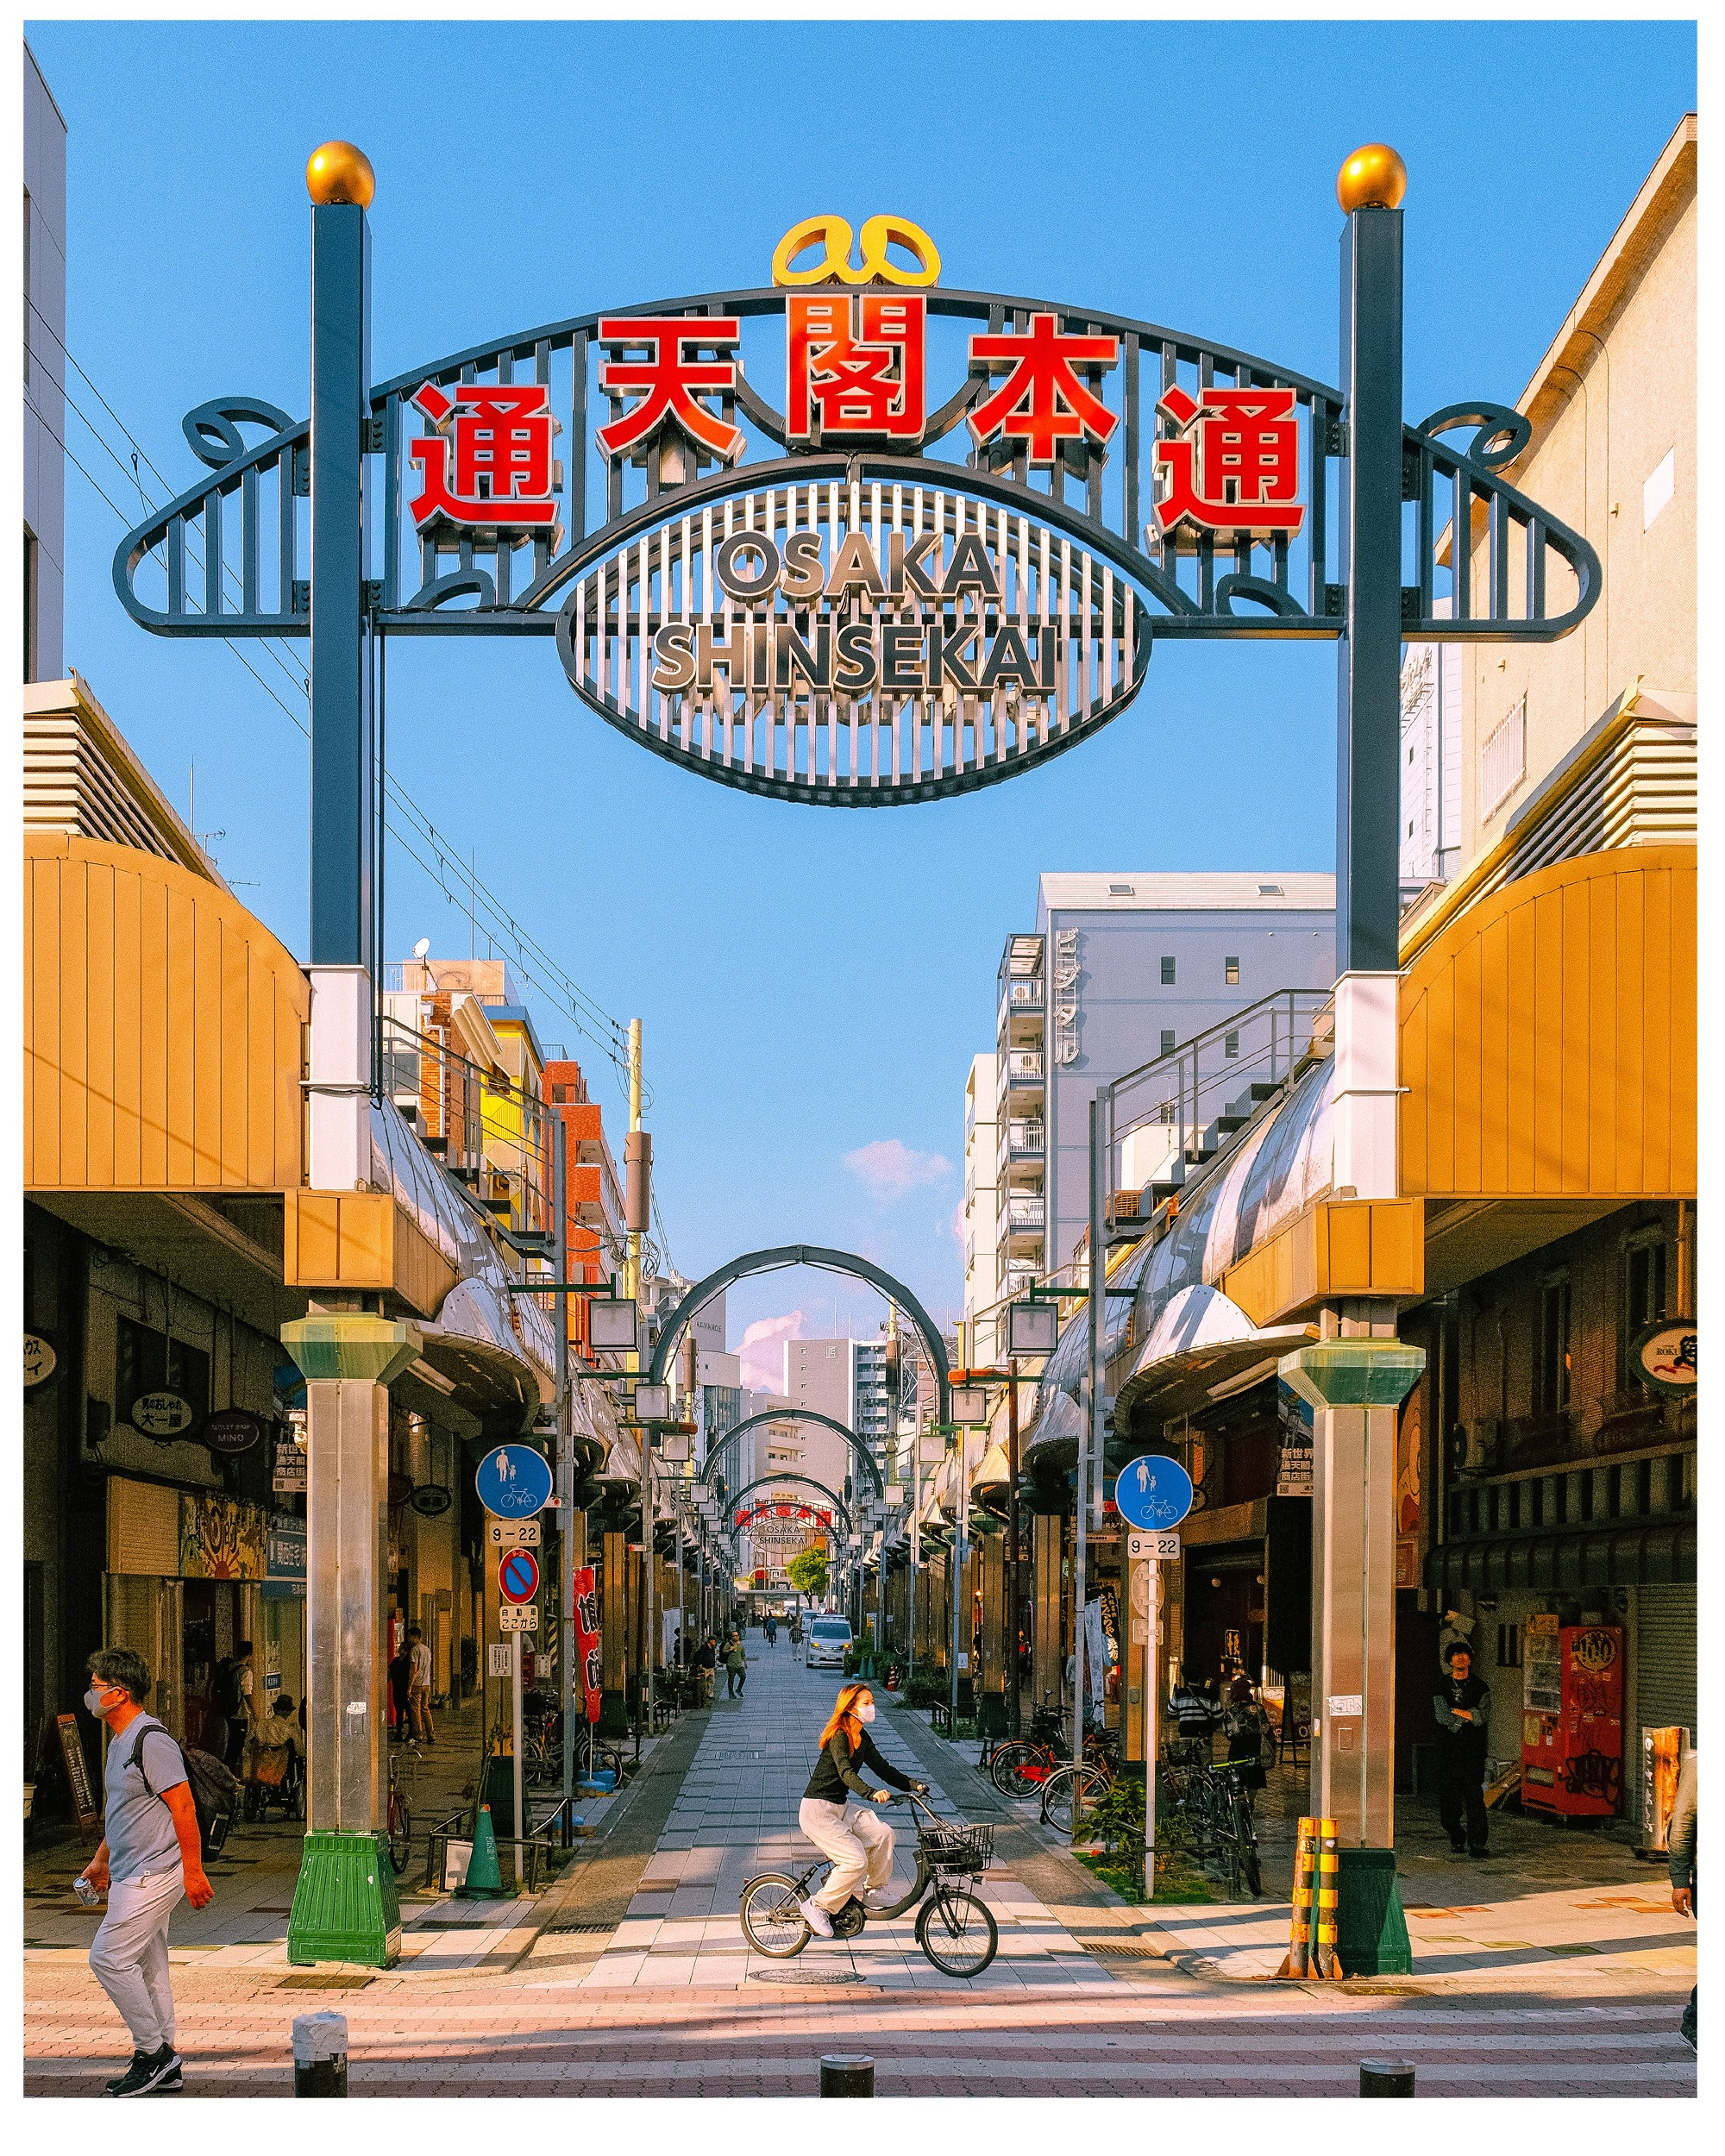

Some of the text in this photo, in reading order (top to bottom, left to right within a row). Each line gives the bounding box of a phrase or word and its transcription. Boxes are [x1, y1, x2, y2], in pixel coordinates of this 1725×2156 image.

[410, 293, 1305, 532] 通天閣本通
[717, 530, 1001, 602] OSAKA
[651, 622, 1057, 695] SHINSEKAI
[217, 1433, 244, 1442] MINO
[759, 1536, 807, 1545] SHINSEKAI
[501, 1619, 536, 1629] ここから
